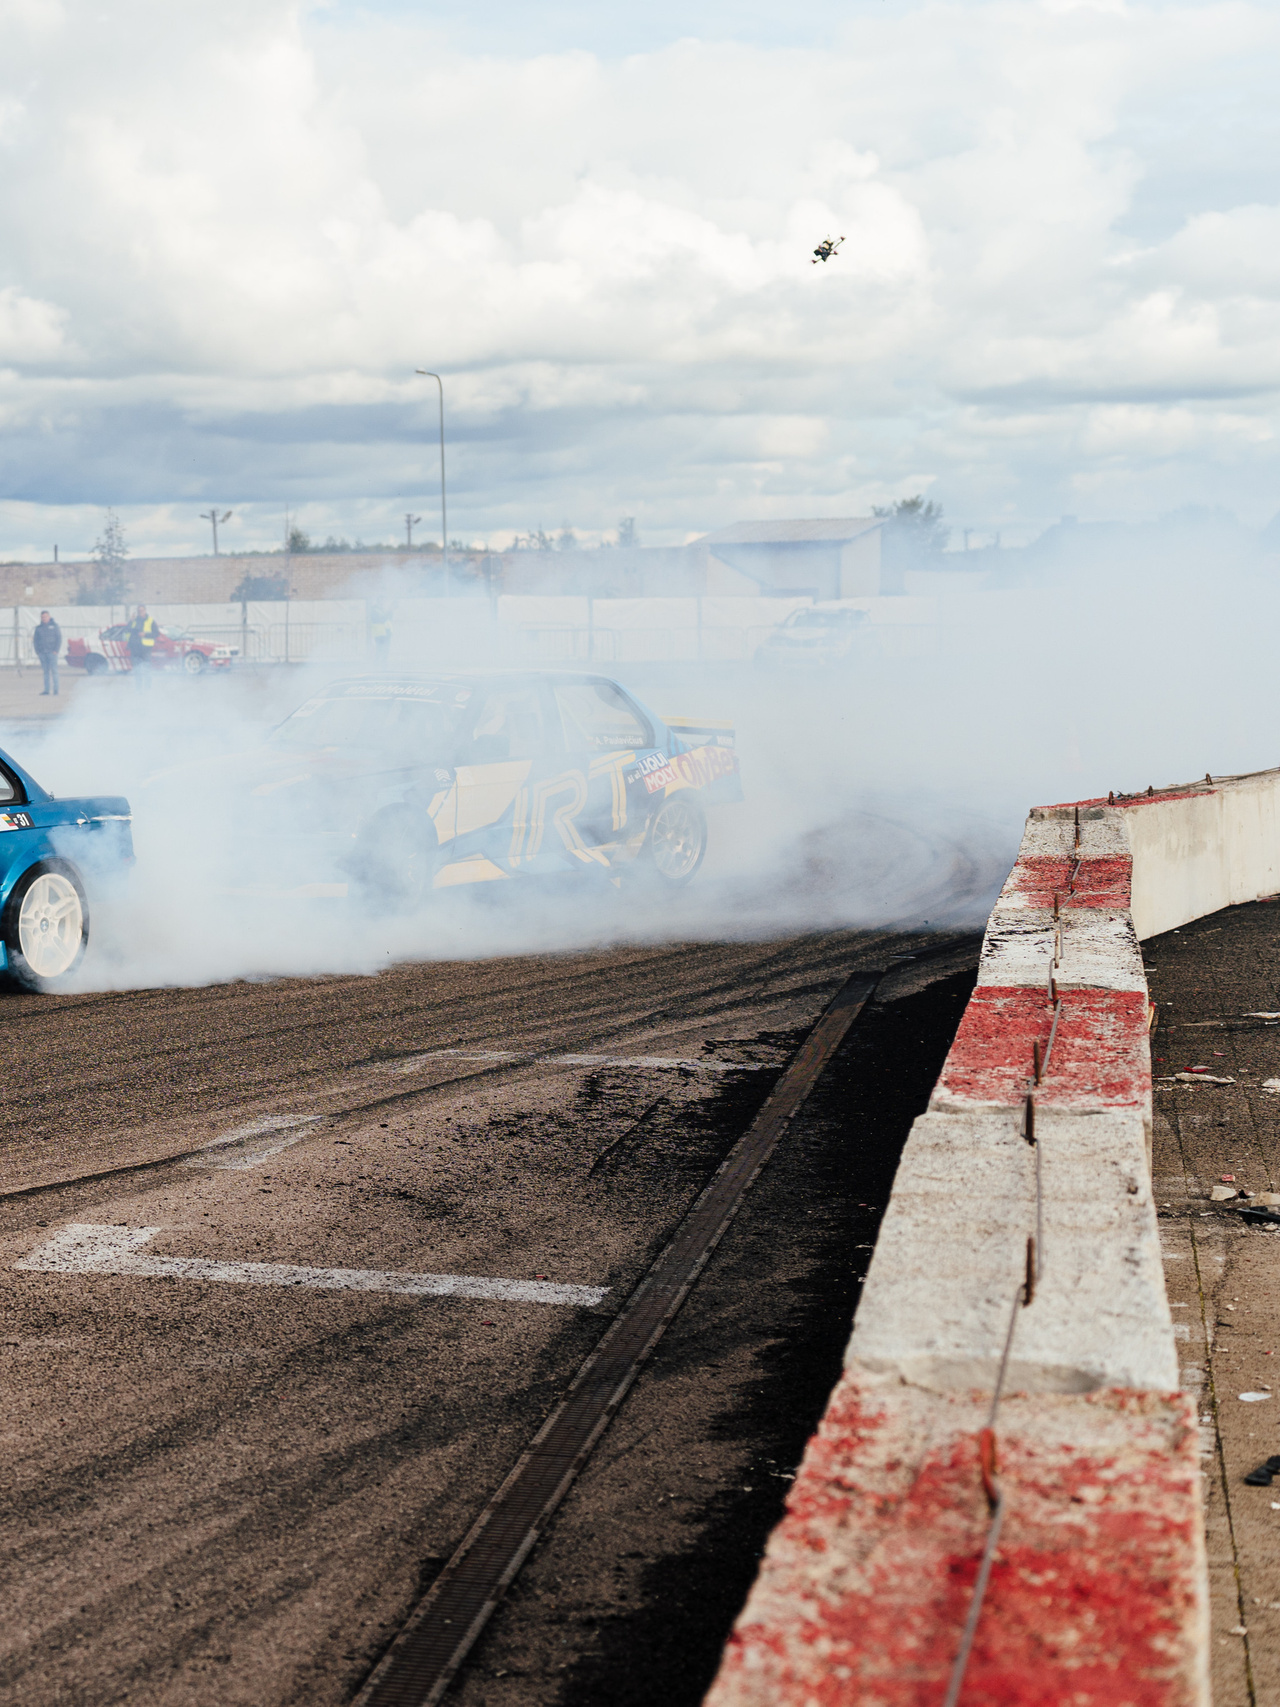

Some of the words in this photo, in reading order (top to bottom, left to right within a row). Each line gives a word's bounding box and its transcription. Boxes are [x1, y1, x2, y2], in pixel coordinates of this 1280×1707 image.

[638, 752, 669, 776] LIQUI
[643, 766, 677, 791] MOLY
[16, 813, 30, 827] 31
